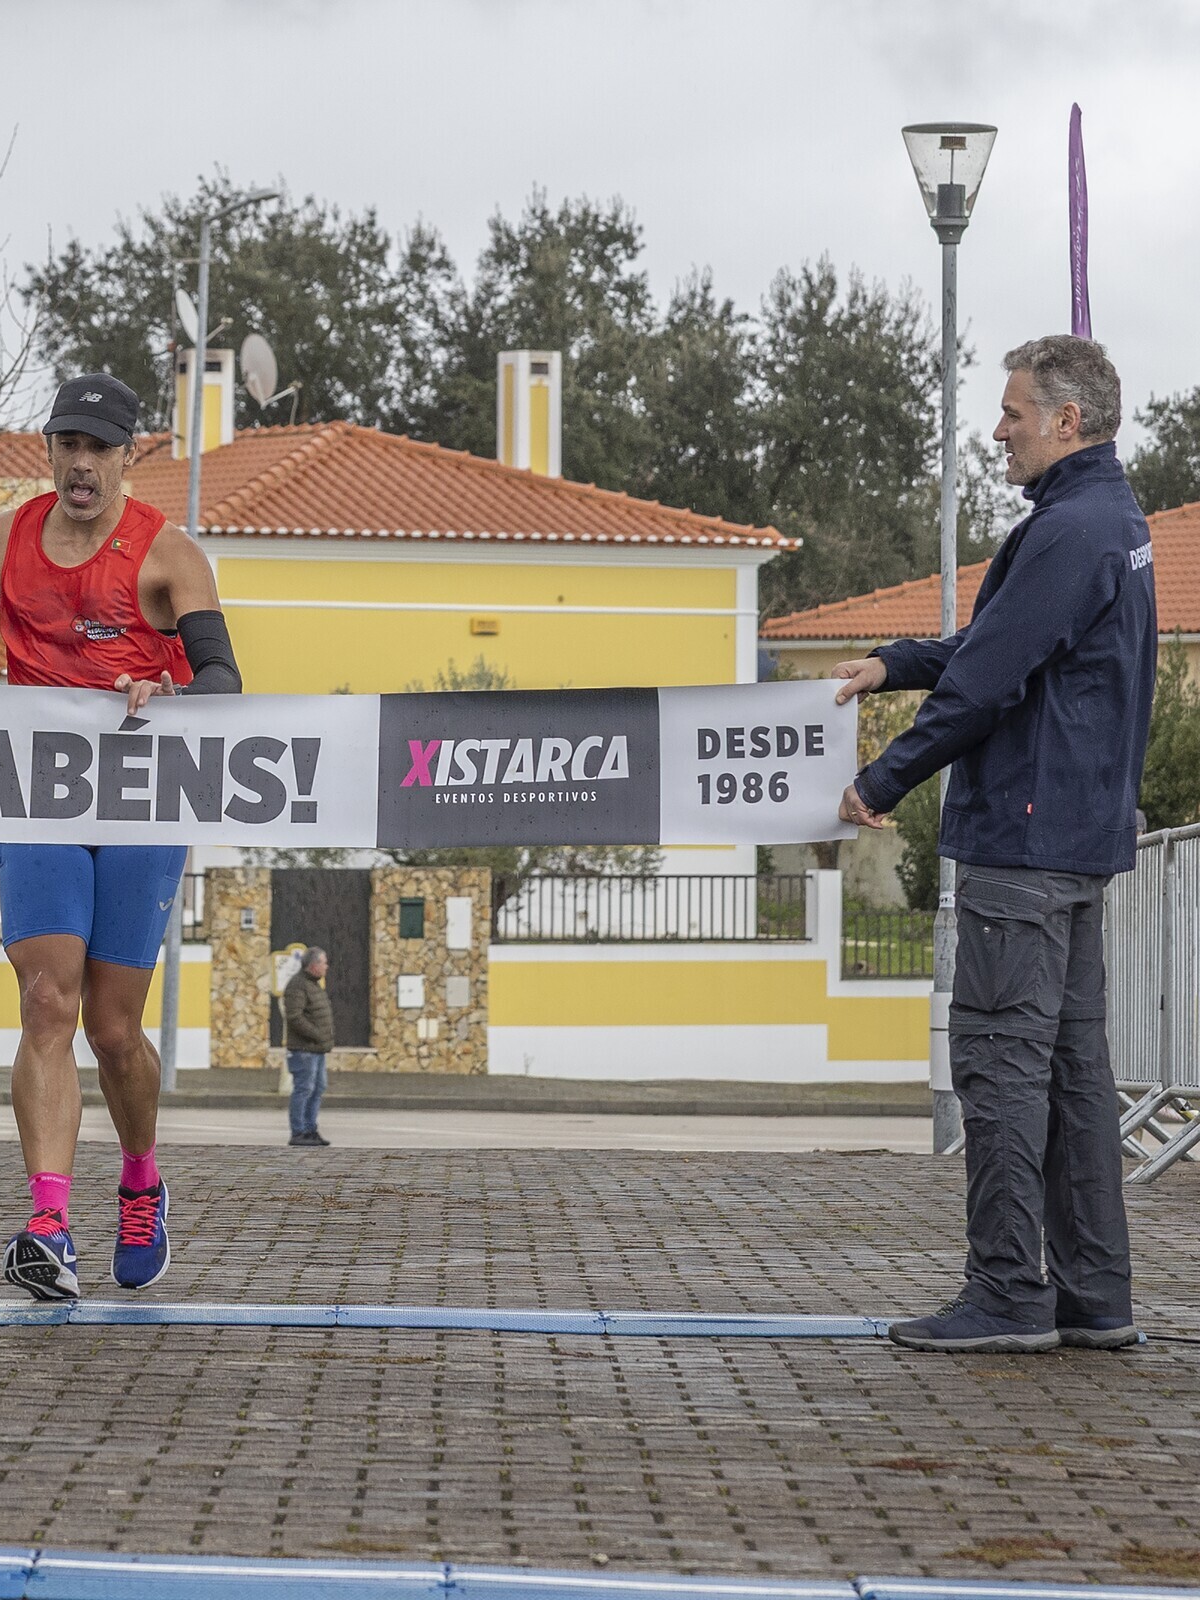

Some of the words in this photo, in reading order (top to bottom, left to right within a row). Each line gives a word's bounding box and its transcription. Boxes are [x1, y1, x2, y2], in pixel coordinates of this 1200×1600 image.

[697, 724, 825, 760] DESDE
[400, 735, 630, 787] XISTARCA
[435, 792, 494, 804] EVENTOS
[503, 791, 597, 803] DESPORTIVOS
[697, 770, 790, 805] 1986
